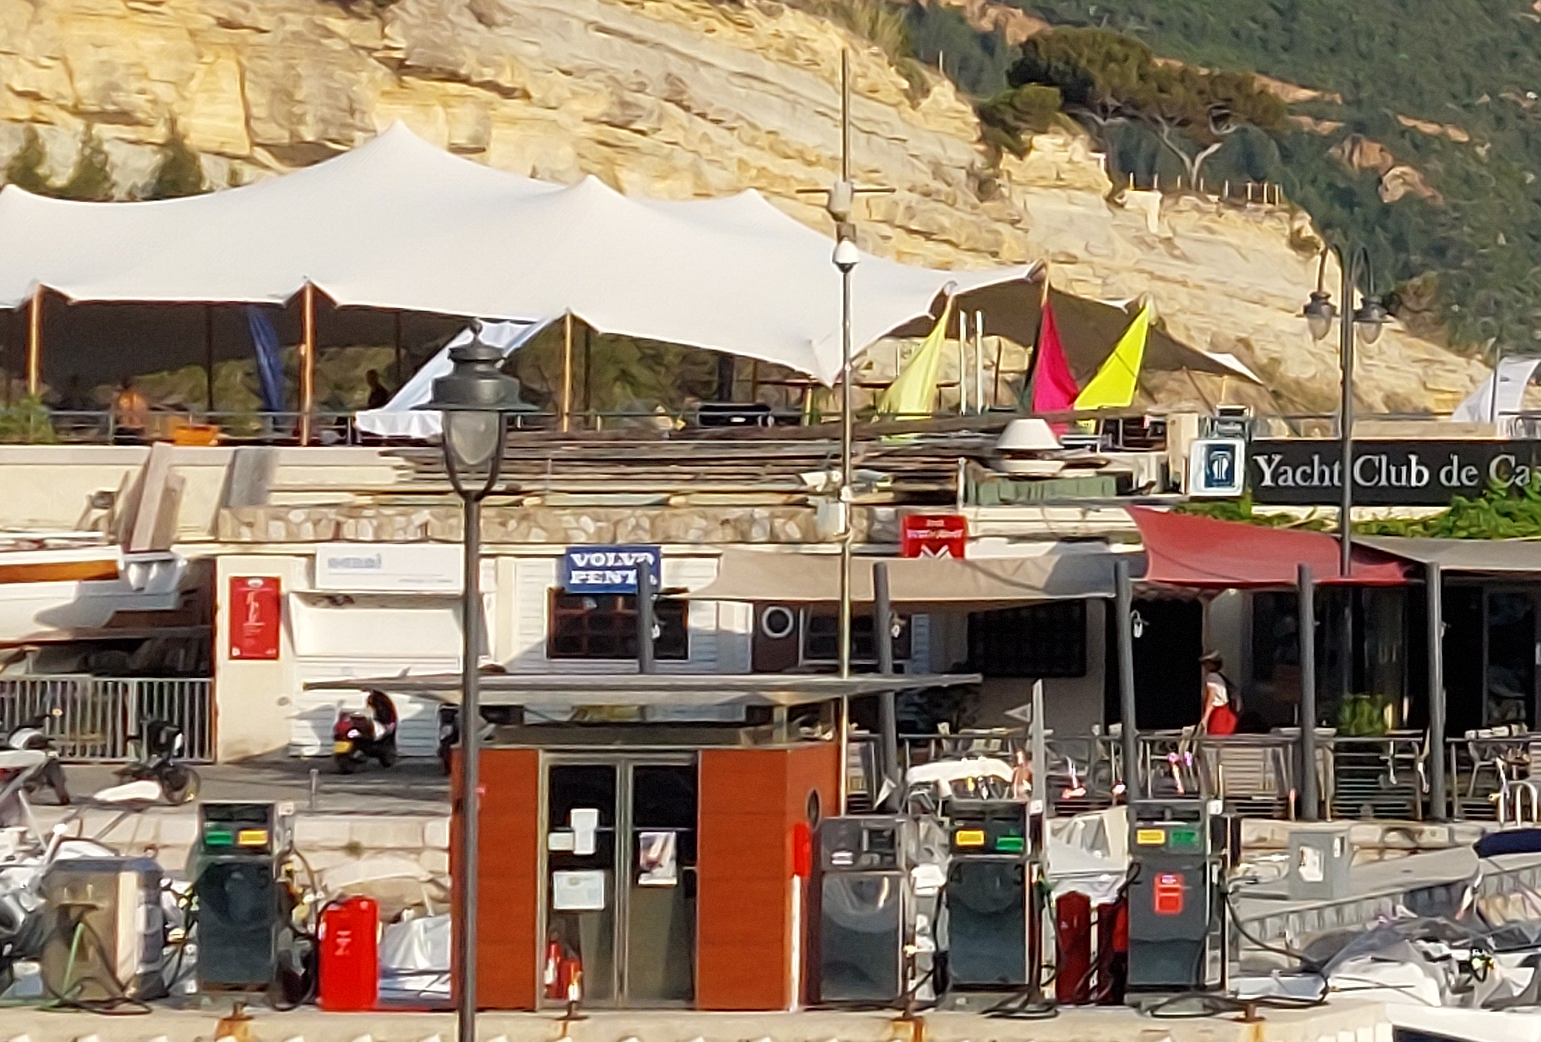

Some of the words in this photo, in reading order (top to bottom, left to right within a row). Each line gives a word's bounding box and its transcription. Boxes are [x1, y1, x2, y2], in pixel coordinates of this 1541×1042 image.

[1252, 454, 1342, 487] Yacht
[1353, 454, 1430, 487] Club
[1439, 453, 1479, 487] de
